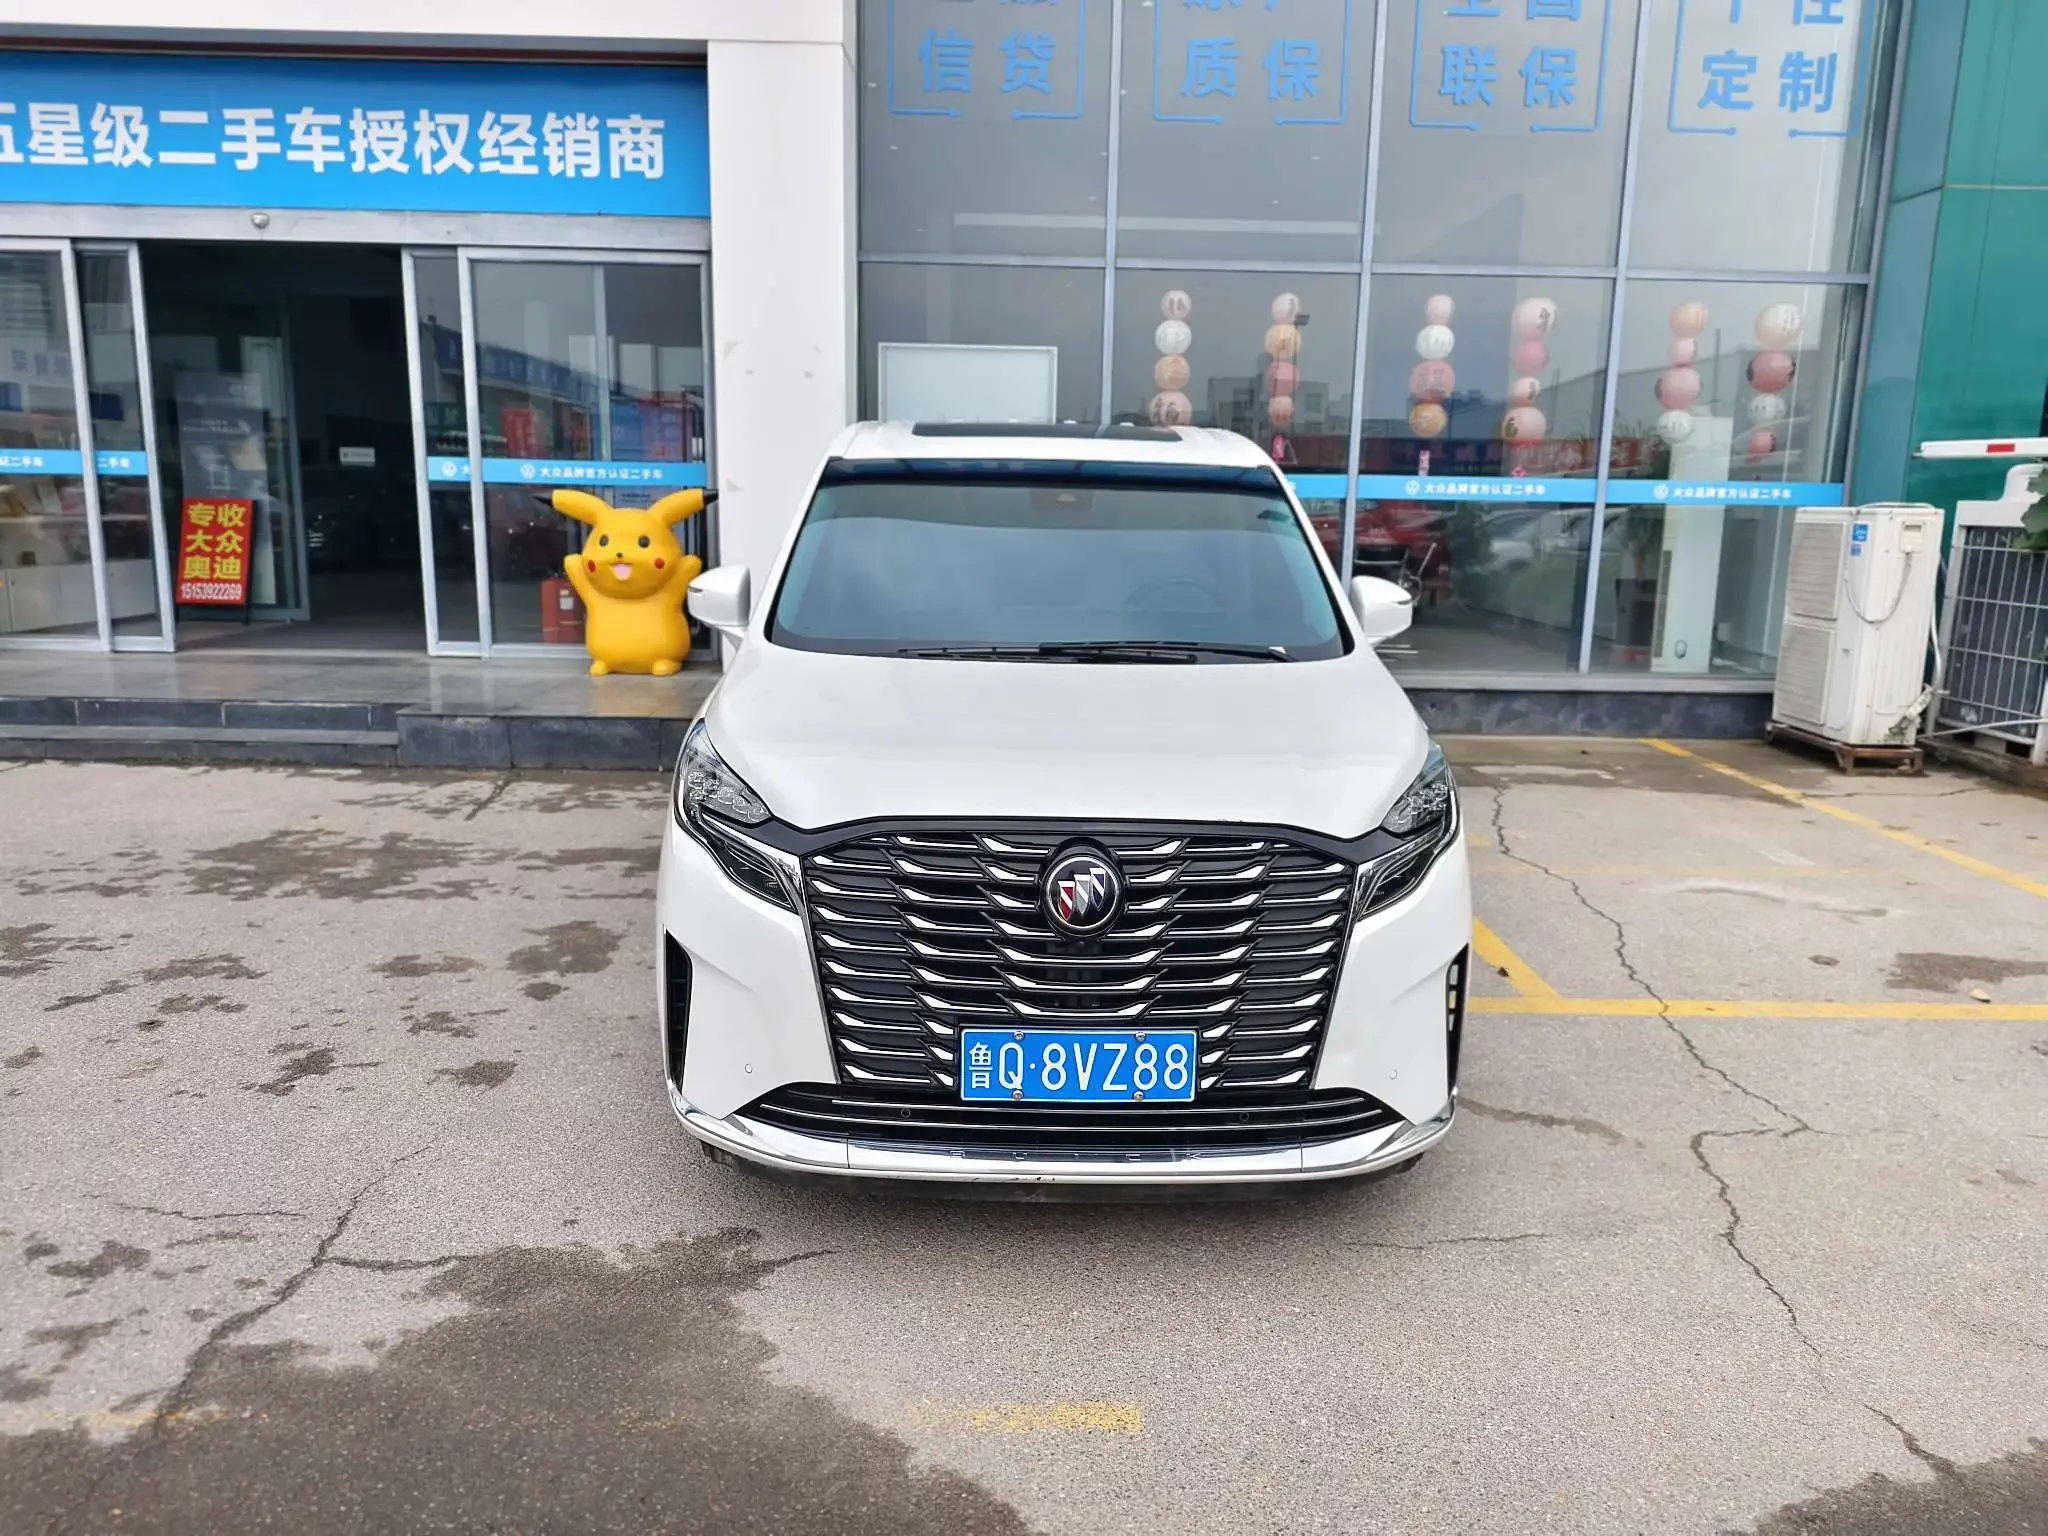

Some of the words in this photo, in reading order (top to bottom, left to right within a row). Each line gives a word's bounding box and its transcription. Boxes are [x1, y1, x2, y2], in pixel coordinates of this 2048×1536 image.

[917, 27, 1056, 95] 信贷
[1180, 37, 1322, 100] 质保
[1438, 44, 1579, 108] 联保
[1697, 49, 1839, 114] 定制
[540, 466, 664, 481] 大众品牌官方认证二手车
[1424, 481, 1546, 496] 大众品牌官方认证二手车
[1673, 487, 1793, 500] 大众品牌官方认证二手车
[187, 502, 246, 527] 专收
[185, 529, 244, 553] 大众
[183, 555, 242, 580] 奥迪
